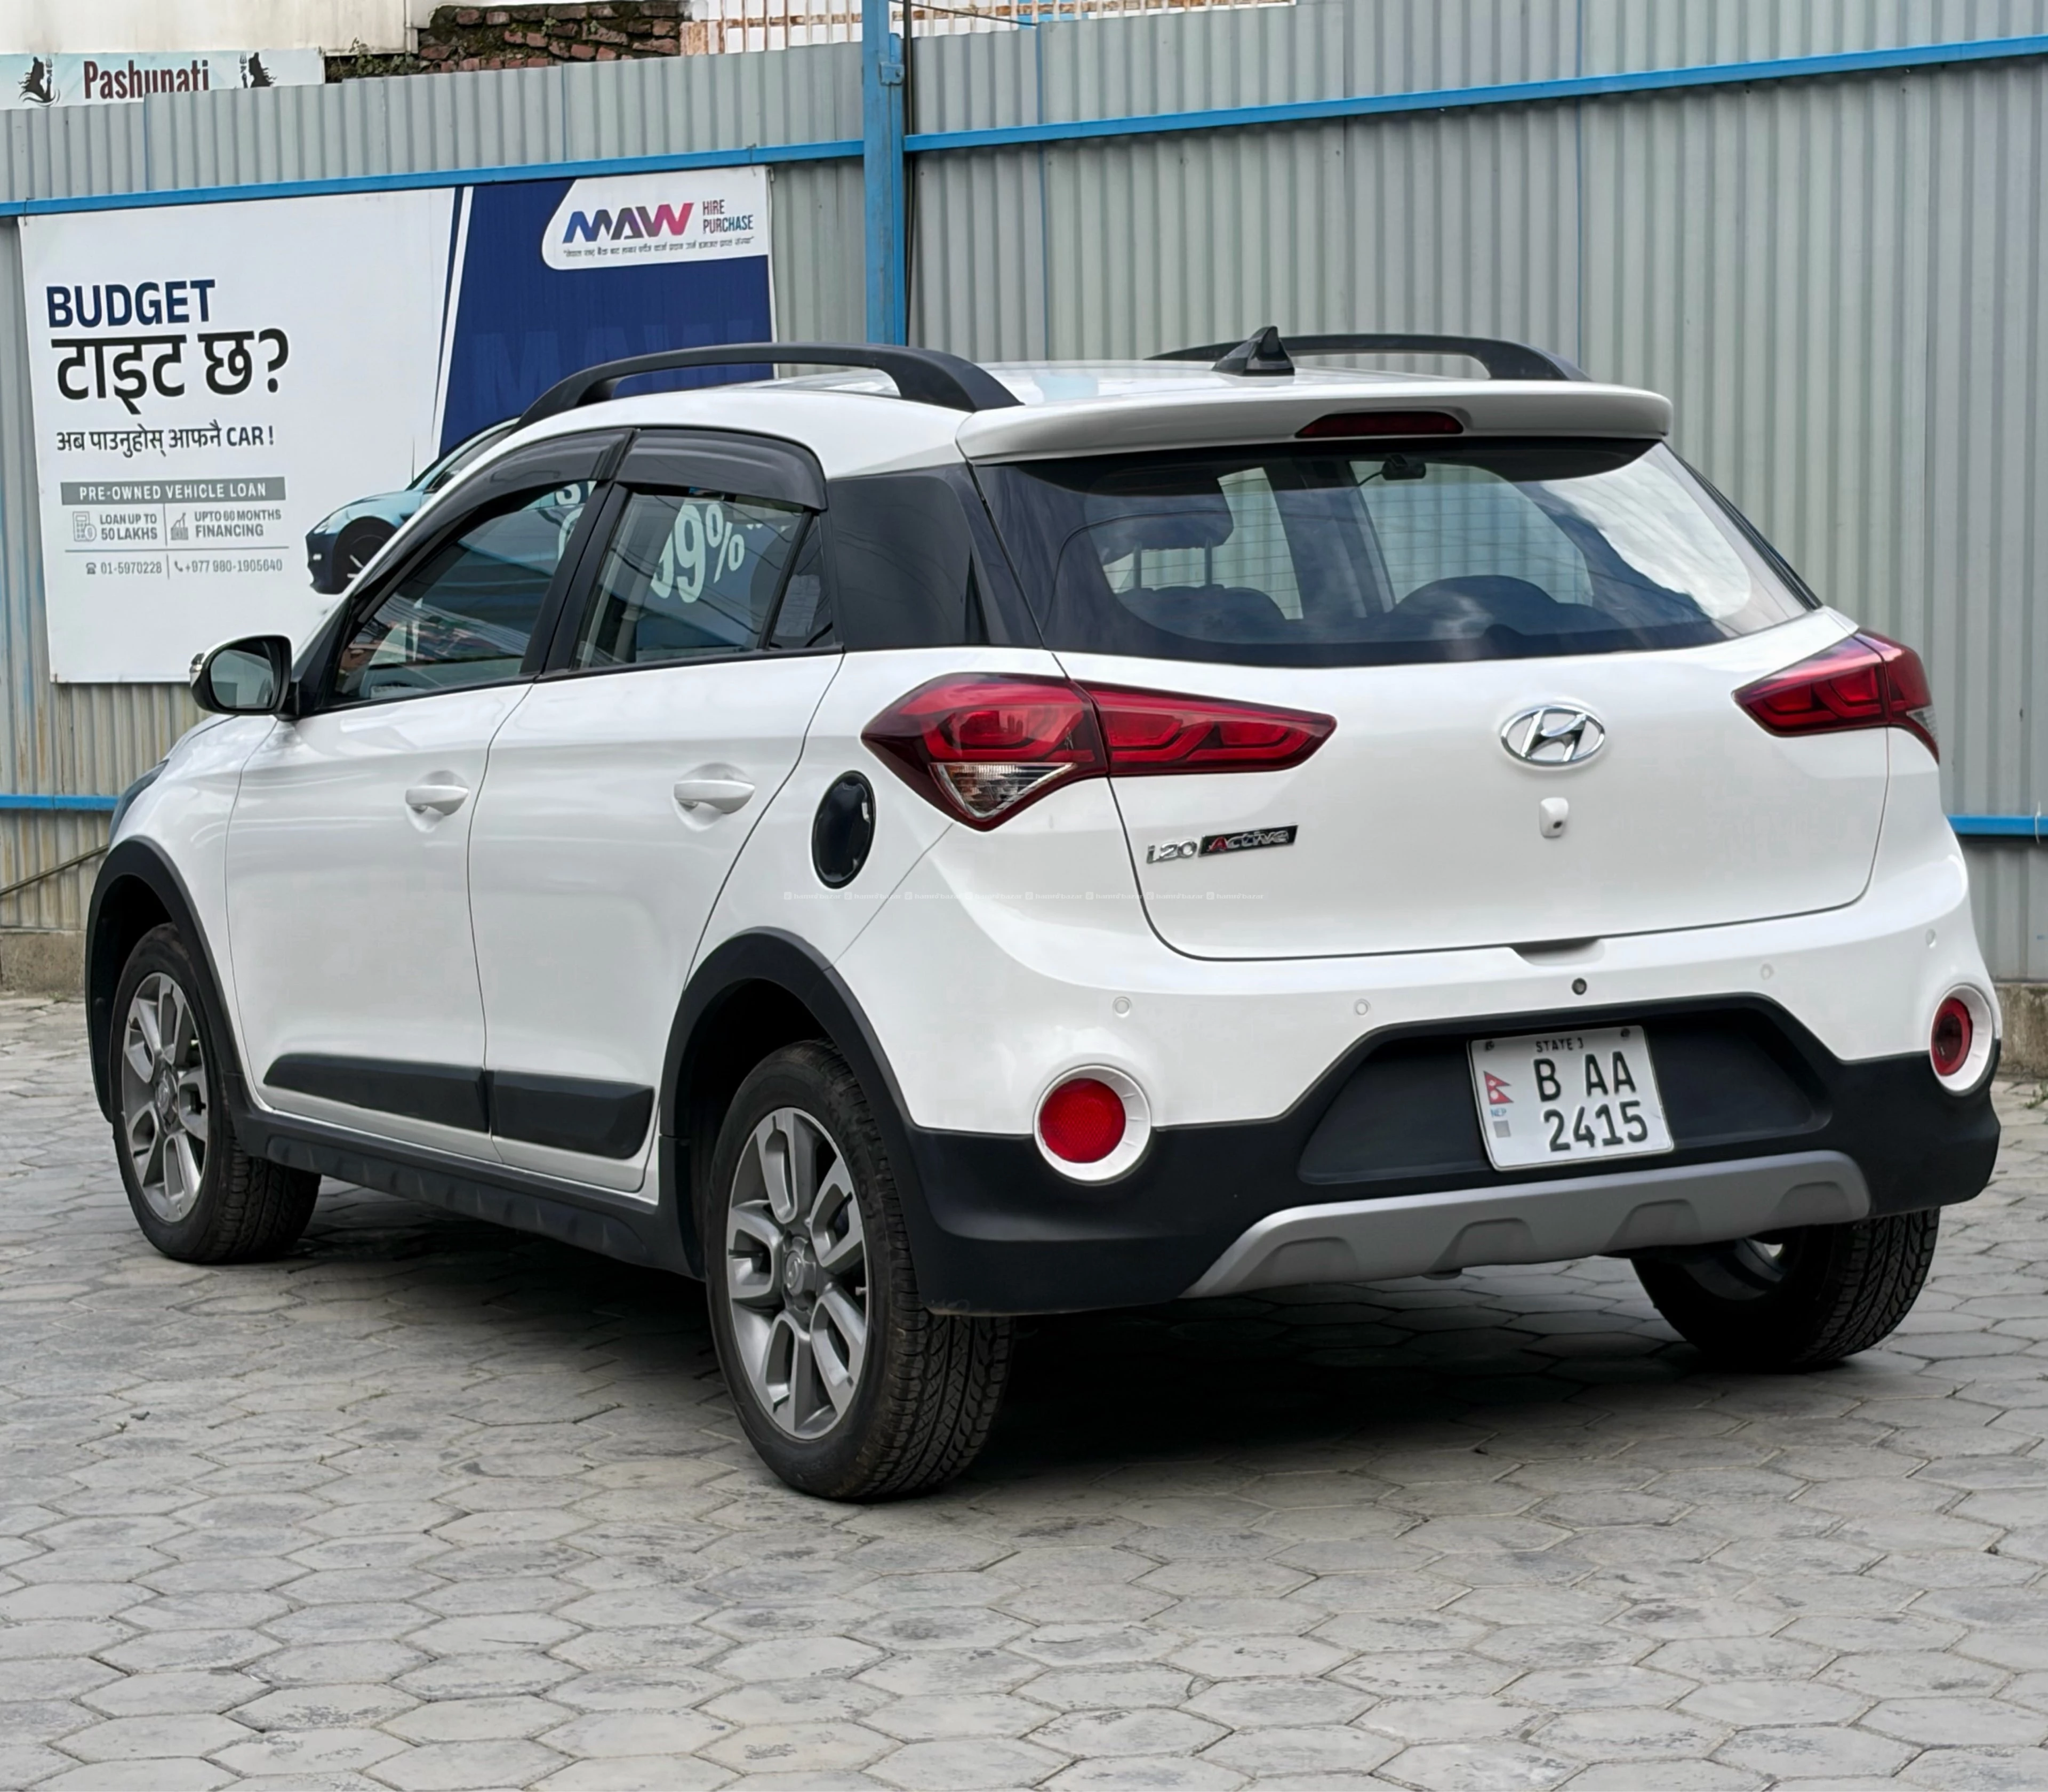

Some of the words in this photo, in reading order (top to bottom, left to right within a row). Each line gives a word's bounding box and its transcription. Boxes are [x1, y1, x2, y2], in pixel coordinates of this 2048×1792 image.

[702, 199, 725, 215] HIRE
[562, 202, 694, 244] MAW
[702, 214, 754, 234] PURCHASE
[46, 279, 215, 328] BUDGET
[51, 334, 187, 415] टाइट
[198, 327, 289, 396] छ?
[57, 431, 85, 451] अब
[89, 423, 166, 458] पाउनुहोस्
[79, 486, 161, 500] PRE-OWNED
[165, 484, 225, 498] VEHICLE
[229, 483, 266, 497] LOAN
[100, 514, 126, 525] LOAN
[144, 514, 157, 524] TO
[194, 510, 222, 522] UPTO
[237, 509, 282, 521] MONTHS
[101, 527, 115, 540] 50
[117, 527, 158, 540] LAKHS
[195, 524, 264, 538] FINANCING
[1207, 830, 1289, 853] Active
[1535, 1038, 1573, 1053] STATE
[1533, 1058, 1561, 1102] B
[1585, 1051, 1636, 1097] AA
[1543, 1100, 1648, 1152] 2415
